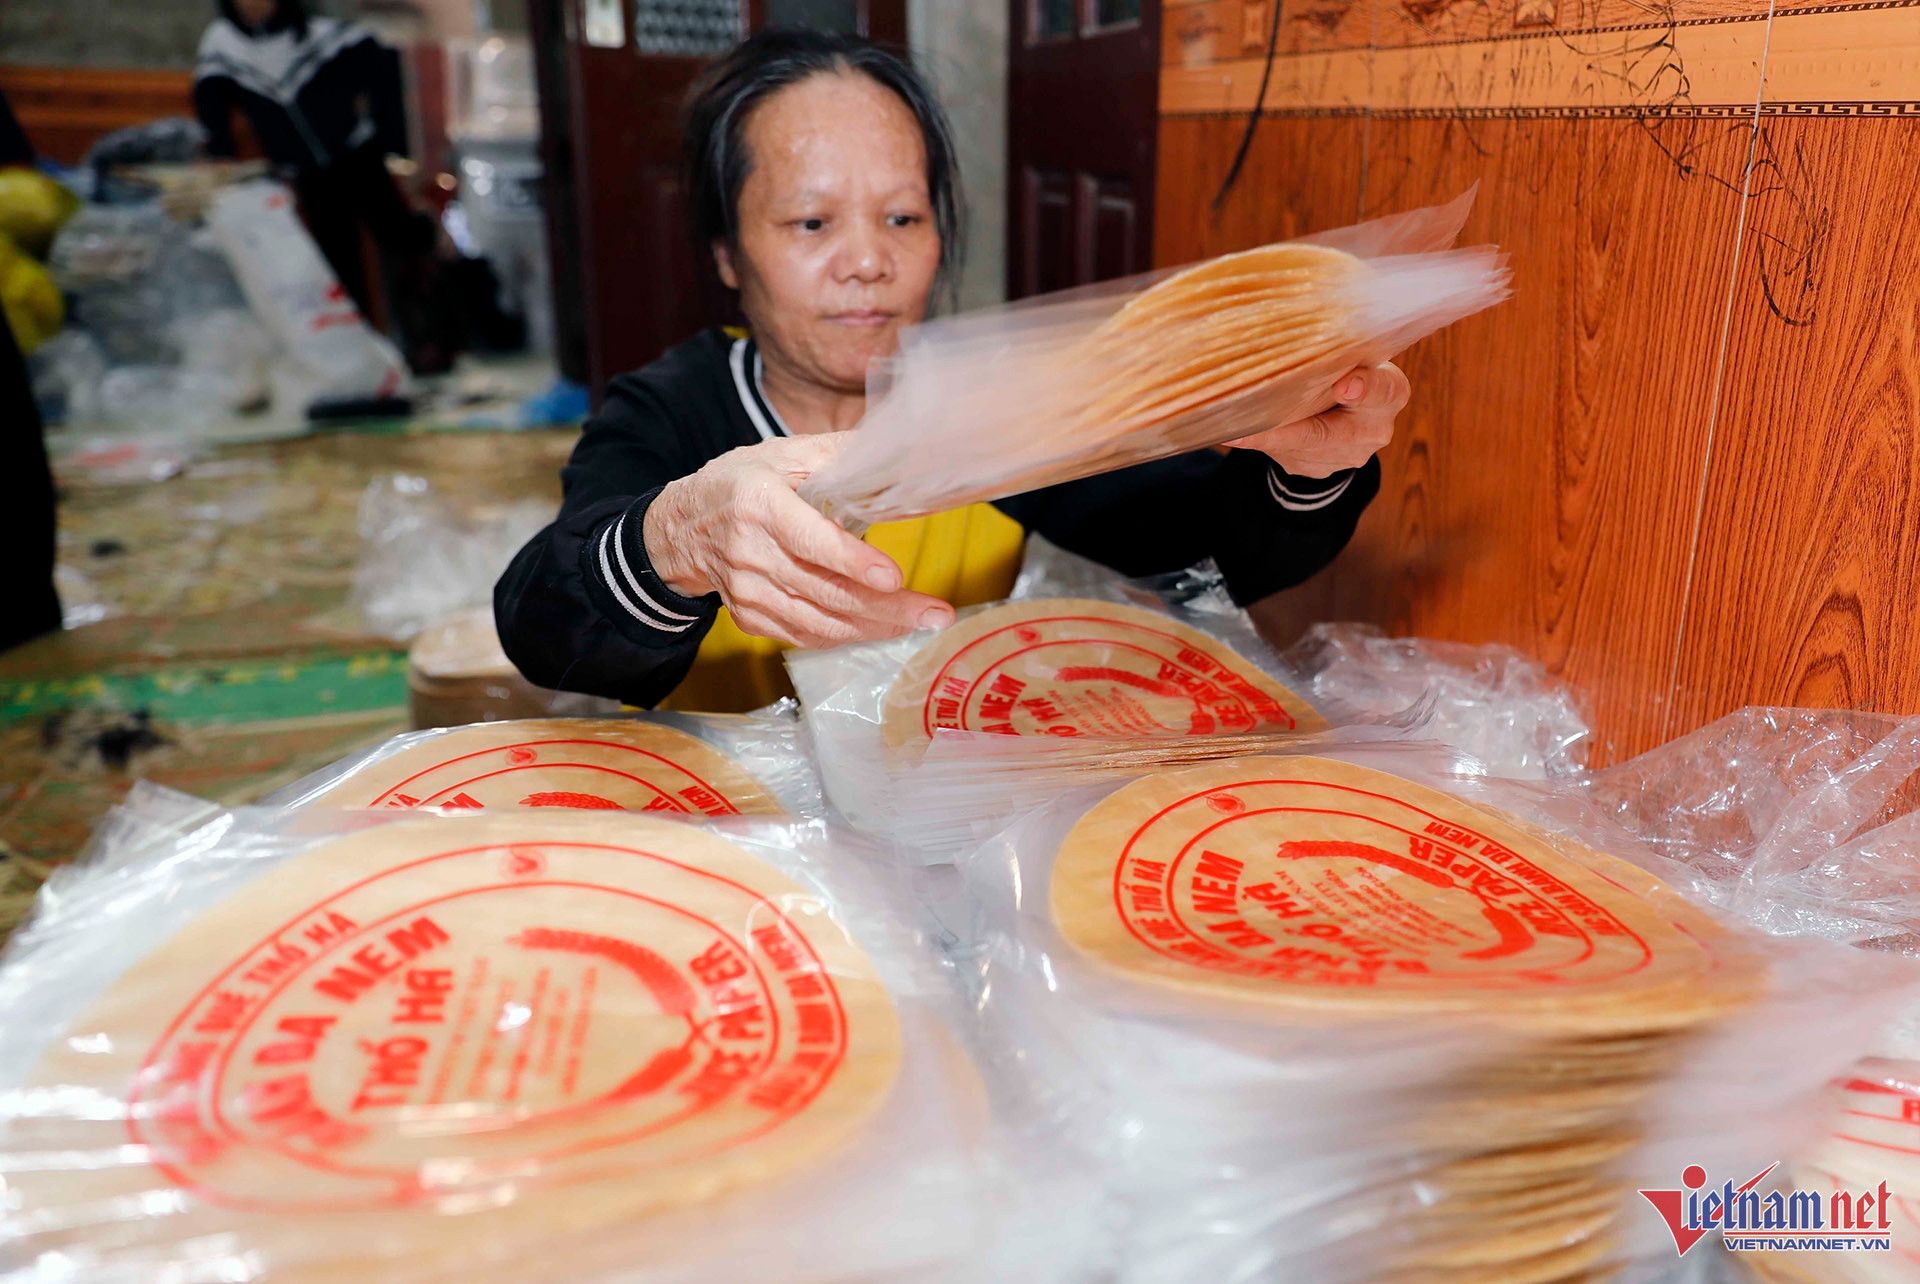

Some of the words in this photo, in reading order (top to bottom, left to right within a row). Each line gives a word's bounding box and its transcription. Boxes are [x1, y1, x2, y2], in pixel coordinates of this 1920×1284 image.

[1409, 836, 1524, 897] PAPER
[1424, 821, 1477, 849] NEM
[1192, 850, 1245, 915] NEM
[312, 916, 451, 1004] NEM
